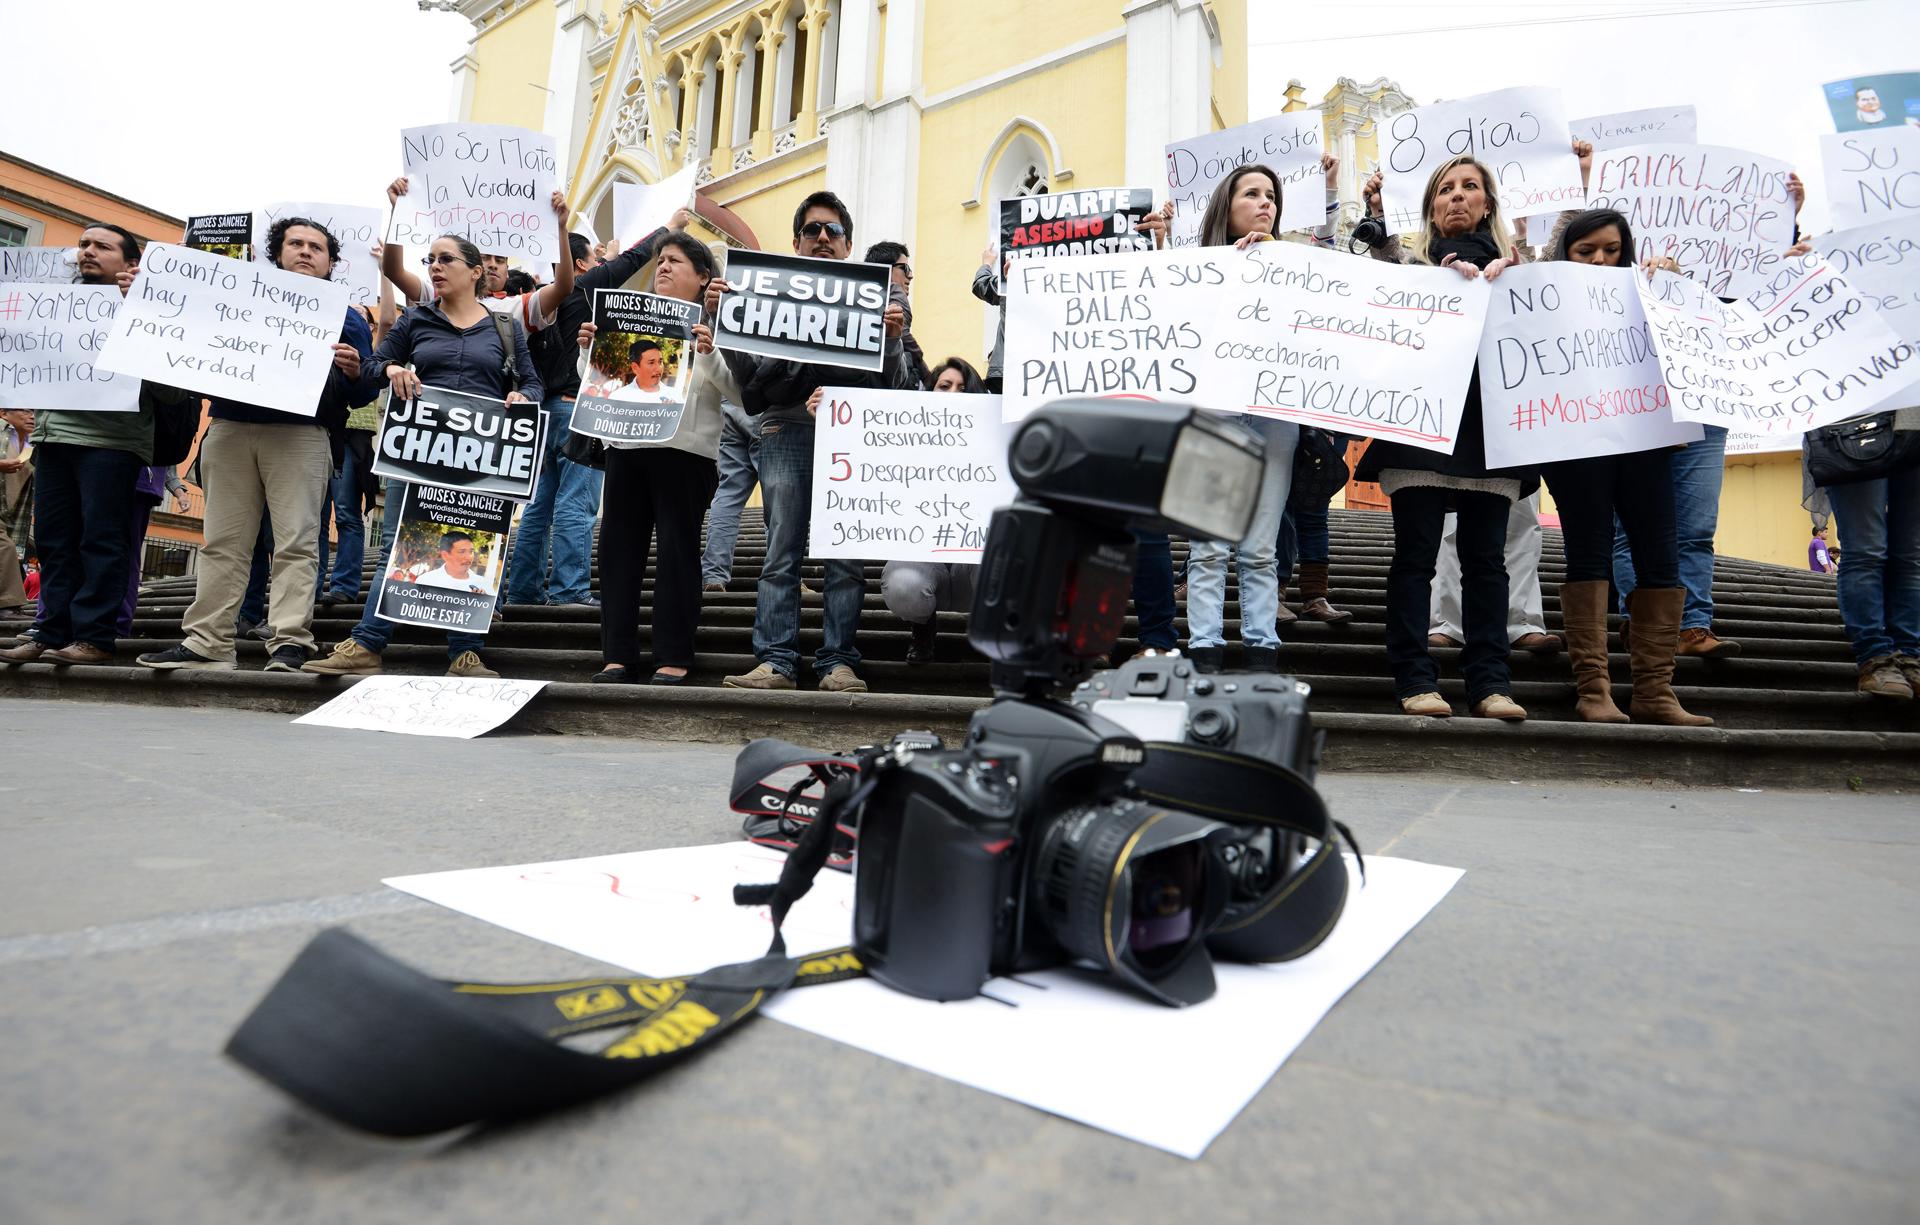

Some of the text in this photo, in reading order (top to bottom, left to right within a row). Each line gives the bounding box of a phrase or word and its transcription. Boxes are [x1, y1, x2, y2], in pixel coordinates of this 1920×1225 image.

[499, 137, 556, 175] Mata
[1263, 124, 1319, 155] Está
[1389, 111, 1541, 173] 8 días
[1842, 139, 1899, 173] SU
[1174, 161, 1326, 218] Moi nchez
[1597, 154, 1694, 194] ERICK
[425, 173, 536, 209] la Verdad
[1020, 189, 1131, 224] DUARTE
[193, 214, 217, 229] MOISÉS
[218, 213, 248, 228] SÁNCHEZ
[415, 202, 541, 232] Matando
[1012, 213, 1141, 247] ASESINO DE
[199, 234, 230, 243] Veracruz
[395, 222, 543, 257] Perdistas
[1174, 233, 1200, 248] Quer
[146, 245, 237, 291] Cuanto
[252, 271, 320, 314] tiempo
[726, 268, 884, 309] JE SUIS
[1022, 261, 1225, 295] FRENTE A SUS
[1240, 249, 1463, 324] Siembre sangre
[142, 277, 337, 341] hay que esperar
[604, 292, 691, 320] MOISÉS SÁNCHEZ
[1065, 294, 1151, 326] BALAS
[1509, 284, 1561, 315] NO
[606, 310, 689, 328] #periodistaSecuestrado
[616, 319, 664, 336] Veracruz
[720, 295, 883, 353] CHARLIE
[1237, 297, 1427, 351] de periodistas
[79, 328, 109, 352] de
[126, 317, 304, 369] para saber la
[1052, 321, 1202, 353] NUESTRAS
[1214, 336, 1341, 372] cosecharán
[1022, 356, 1197, 397] PALABRAS
[581, 400, 679, 419] #LoQueremosVivo
[829, 399, 974, 430] 10 periodistas
[1252, 369, 1444, 438] REVOLUCIÓN
[389, 400, 536, 442] JE SUIS
[593, 417, 662, 437] DÓNDE ESTÁ?
[382, 426, 534, 480] CHARLIE
[863, 429, 969, 447] asesinados
[1725, 441, 1760, 451] onzález
[828, 452, 998, 488] 5 Desaparecidos
[418, 501, 503, 521] #periodistaSecuestrado
[429, 510, 478, 528] Veracruz
[826, 490, 975, 521] Durante este
[831, 520, 925, 546] gobierno
[386, 585, 490, 610] #LoQueremosVivo
[400, 601, 472, 626] DÓNDE ESTÁ?
